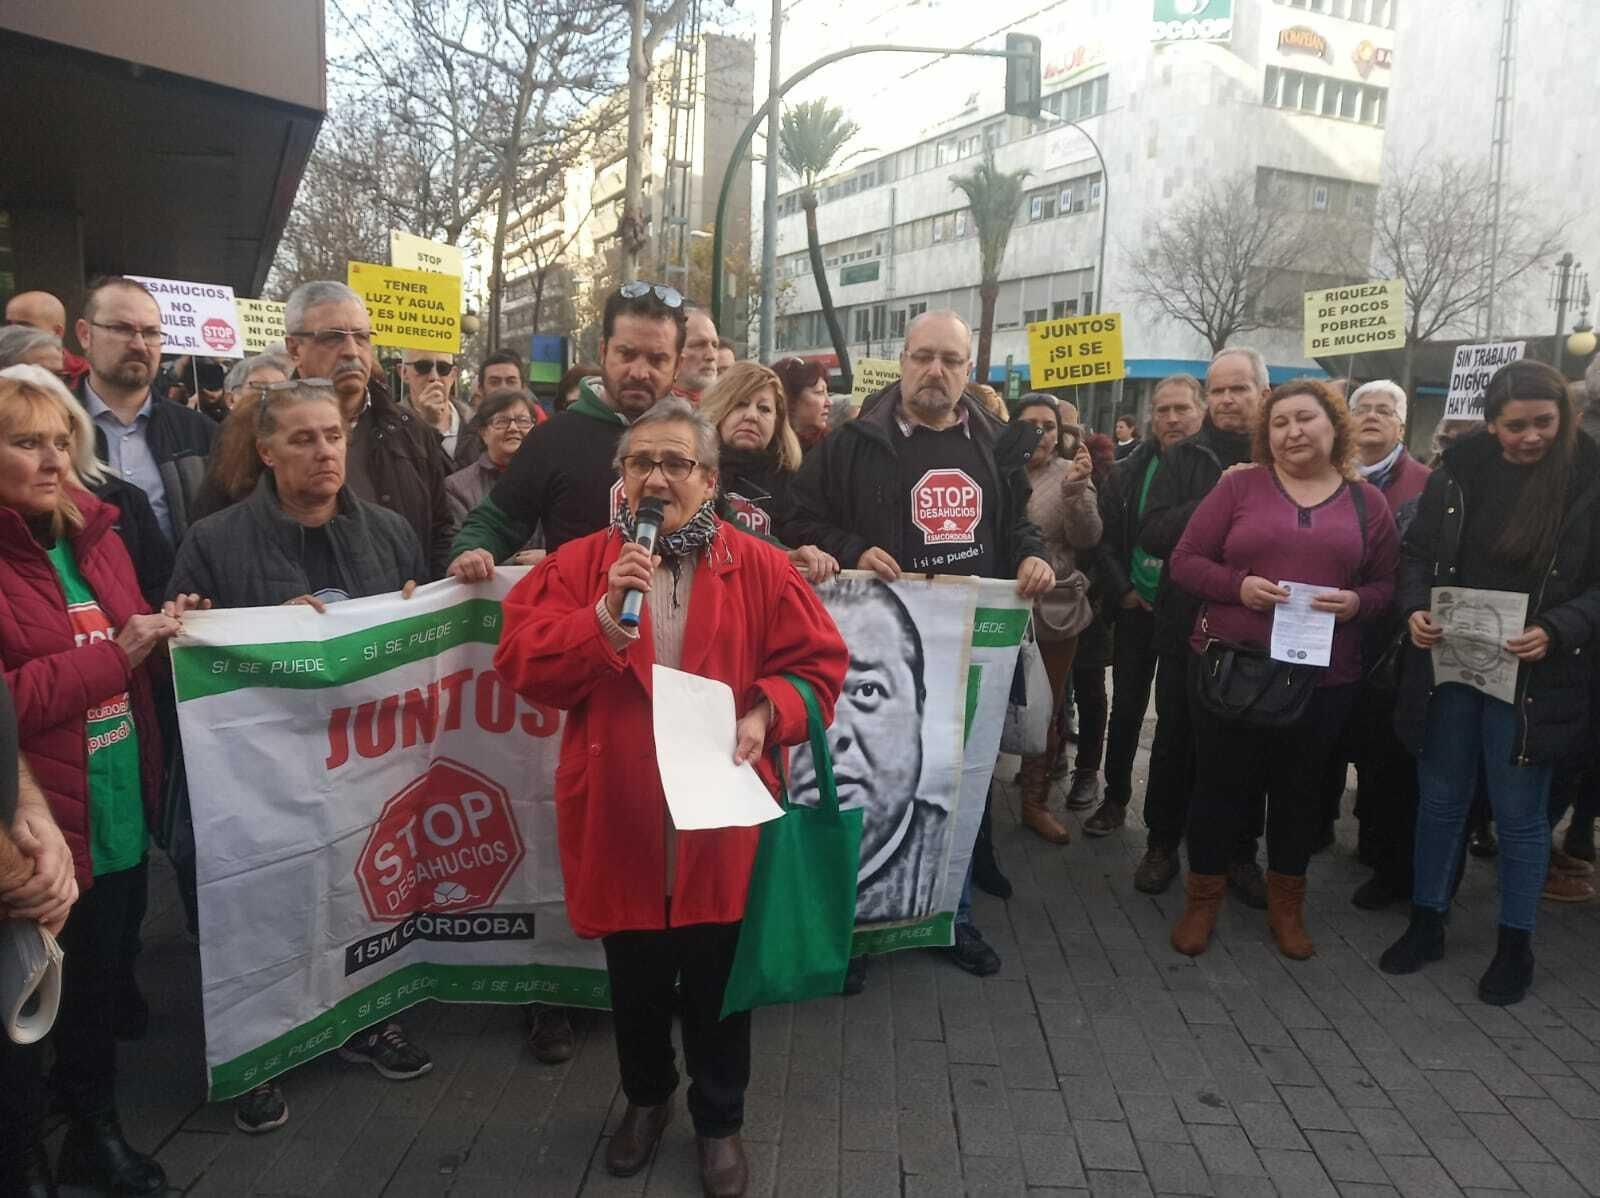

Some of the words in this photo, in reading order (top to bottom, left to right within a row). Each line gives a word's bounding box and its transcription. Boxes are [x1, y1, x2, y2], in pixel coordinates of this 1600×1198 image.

[417, 252, 442, 265] STOP
[384, 279, 428, 294] TENER
[1325, 285, 1389, 302] RIQUEZA
[366, 292, 391, 305] LUZ
[396, 295, 404, 306] Y
[408, 297, 445, 311] AGUA
[1318, 307, 1336, 318] DE
[1341, 300, 1389, 315] POCOS
[160, 313, 196, 328] UILER
[243, 315, 263, 323] SIN
[268, 317, 283, 325] GE
[377, 309, 394, 319] ES
[399, 312, 417, 322] UN
[422, 315, 455, 327] LUJO
[1321, 316, 1387, 332] POBREZA
[203, 326, 233, 338] STOP
[248, 327, 261, 335] NI
[376, 323, 393, 333] UN
[397, 326, 452, 340] DERECHO
[1040, 318, 1116, 339] JUNTOS
[246, 339, 266, 347] SIN
[1312, 338, 1330, 348] DE
[1334, 330, 1396, 346] MUCHOS
[1049, 345, 1072, 363] ¡SI
[1079, 341, 1103, 356] SE
[1456, 350, 1472, 367] SIN
[1474, 346, 1517, 367] TRABAJO
[1044, 361, 1111, 381] PUEDE!
[1447, 397, 1465, 414] HAY
[919, 486, 975, 508] STOP
[920, 507, 976, 519] DESAHUCIOS
[932, 555, 944, 565] se
[238, 661, 262, 675] SE
[270, 658, 325, 675] PUEDE
[385, 638, 401, 654] SE
[409, 623, 451, 644] PUEDE
[325, 668, 559, 770] JUNTOS
[88, 721, 129, 755] pued
[374, 791, 493, 886] STOP
[386, 841, 509, 911] DESAHUCIOS
[354, 932, 398, 964] 15M
[288, 1027, 335, 1057] PUEDE
[377, 993, 392, 1009] SE
[398, 977, 439, 999] PUEDE
[491, 981, 509, 992] SE
[514, 981, 560, 993] PUEDE
